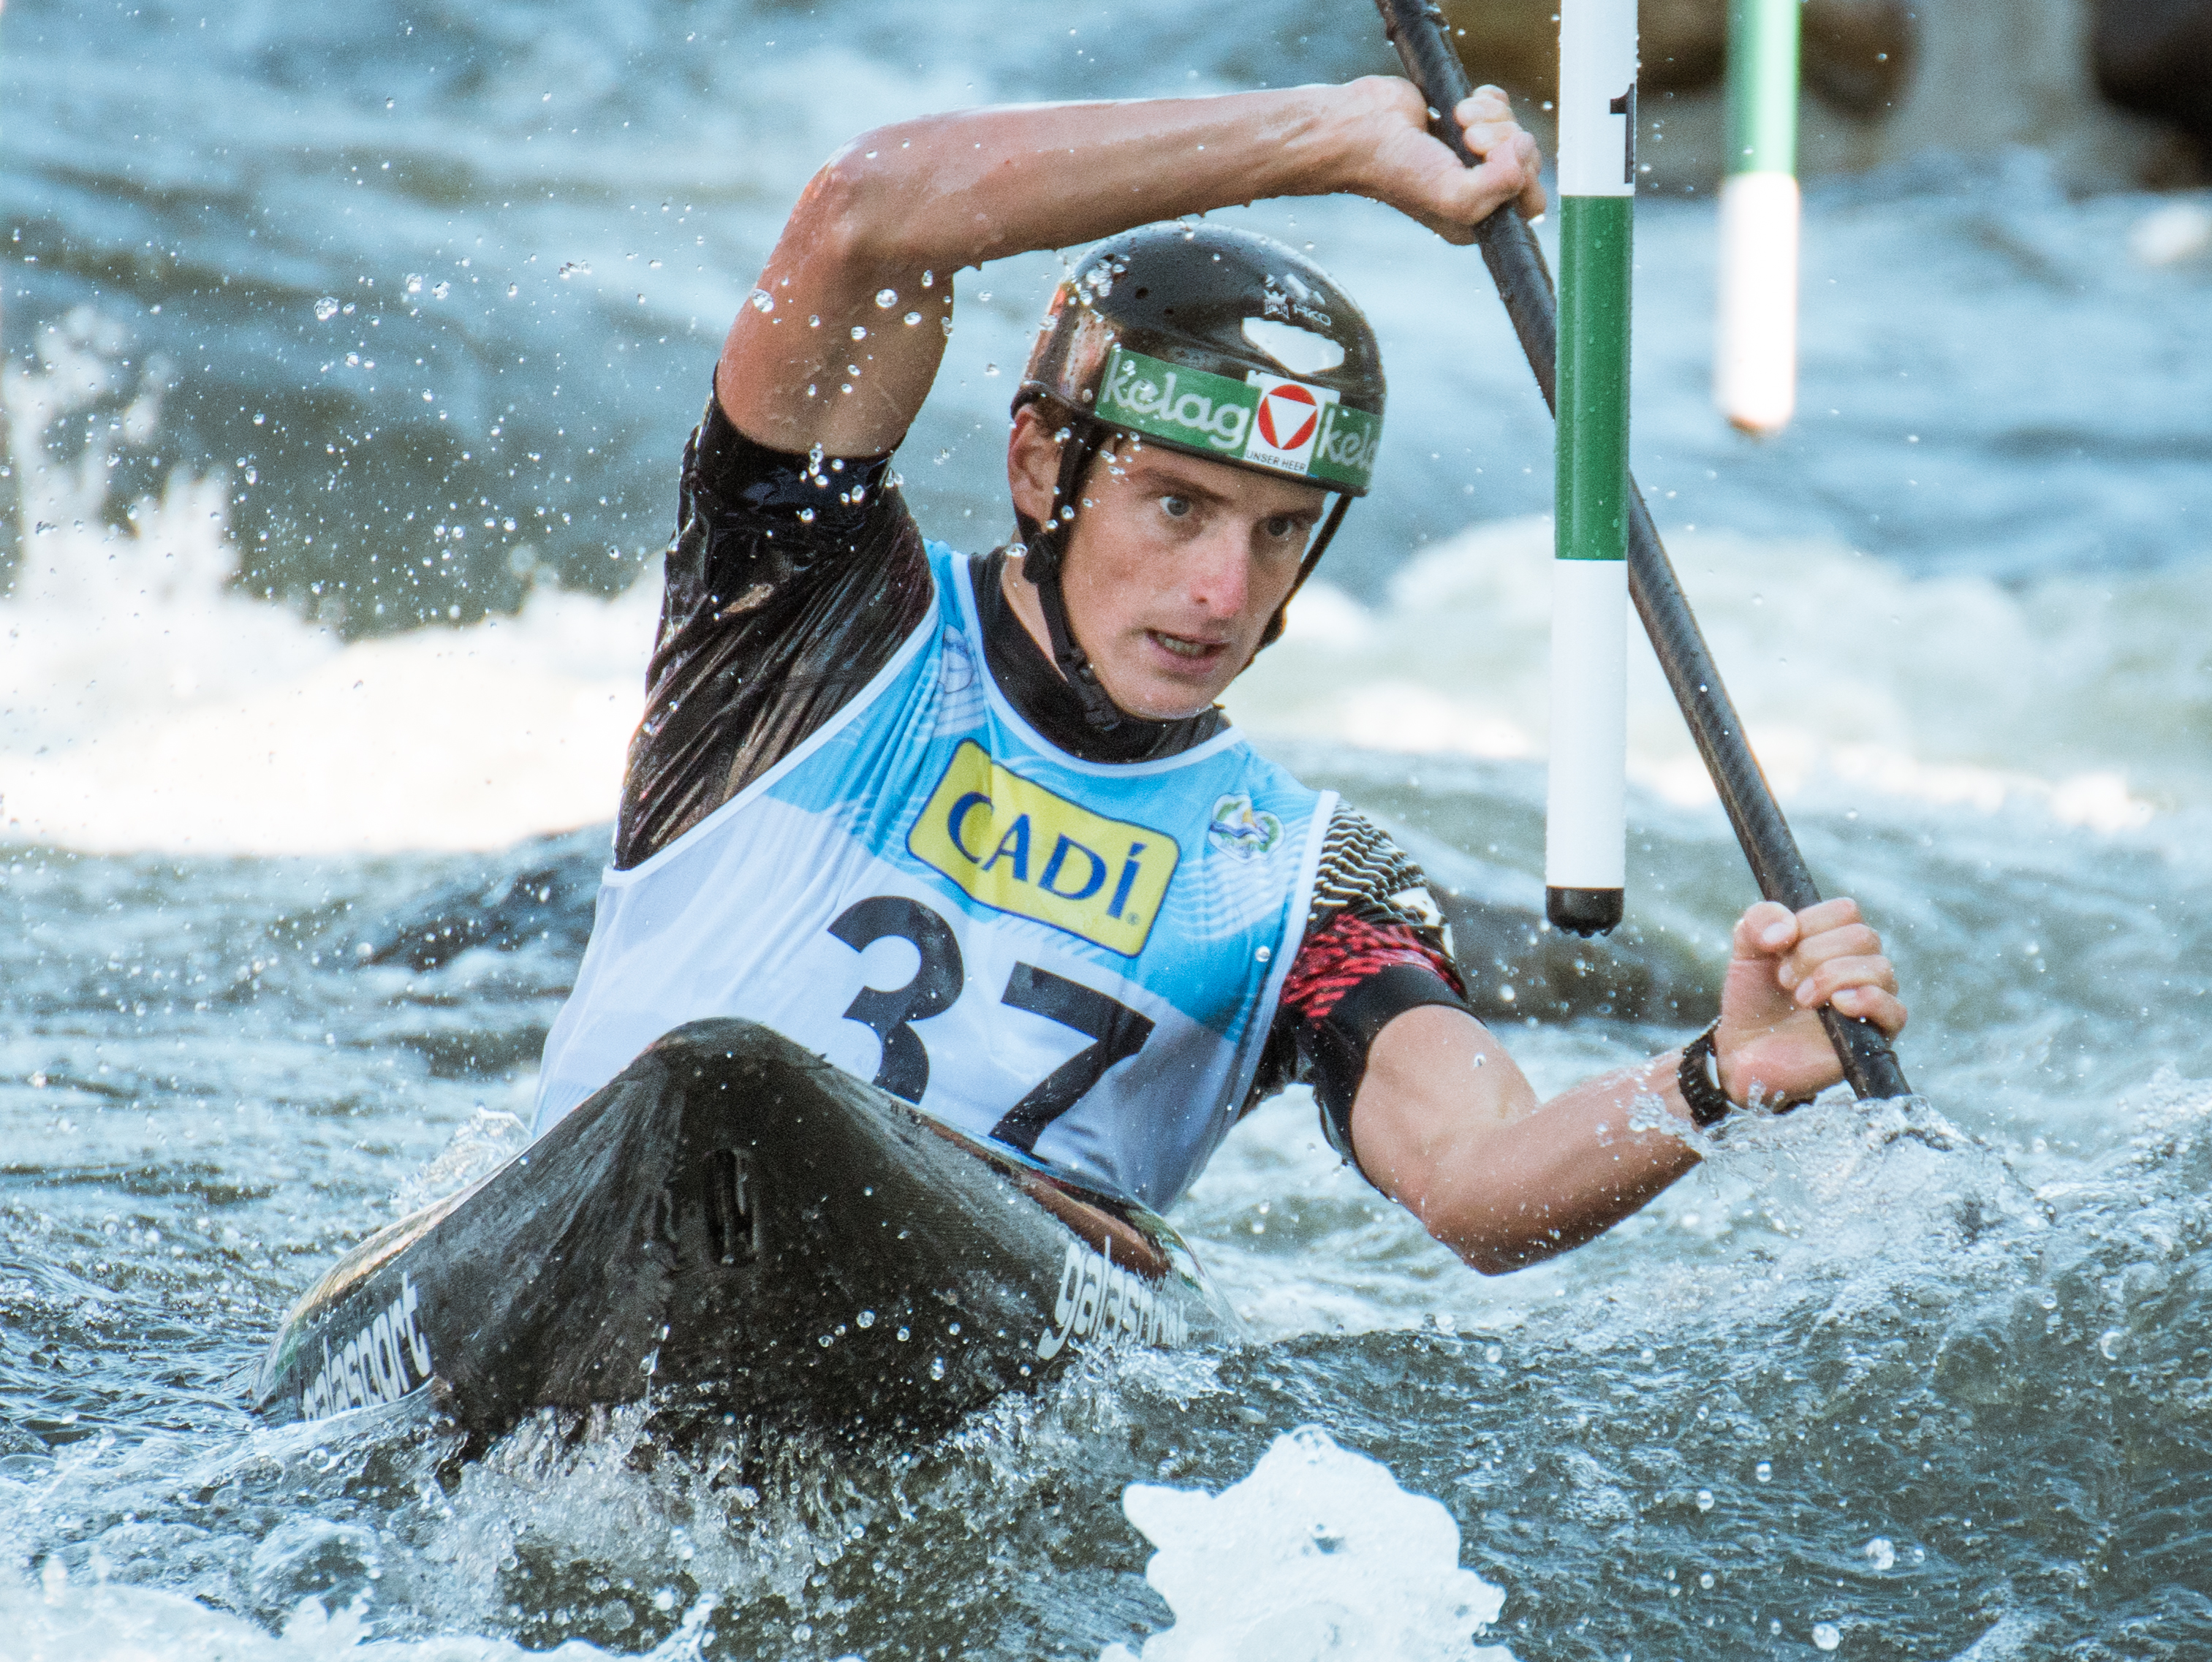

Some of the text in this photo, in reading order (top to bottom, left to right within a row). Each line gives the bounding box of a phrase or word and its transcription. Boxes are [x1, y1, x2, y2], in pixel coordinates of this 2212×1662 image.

[1102, 349, 1251, 449] kelag
[1245, 449, 1306, 474] UNSER HEER
[827, 895, 1156, 1155] 37
